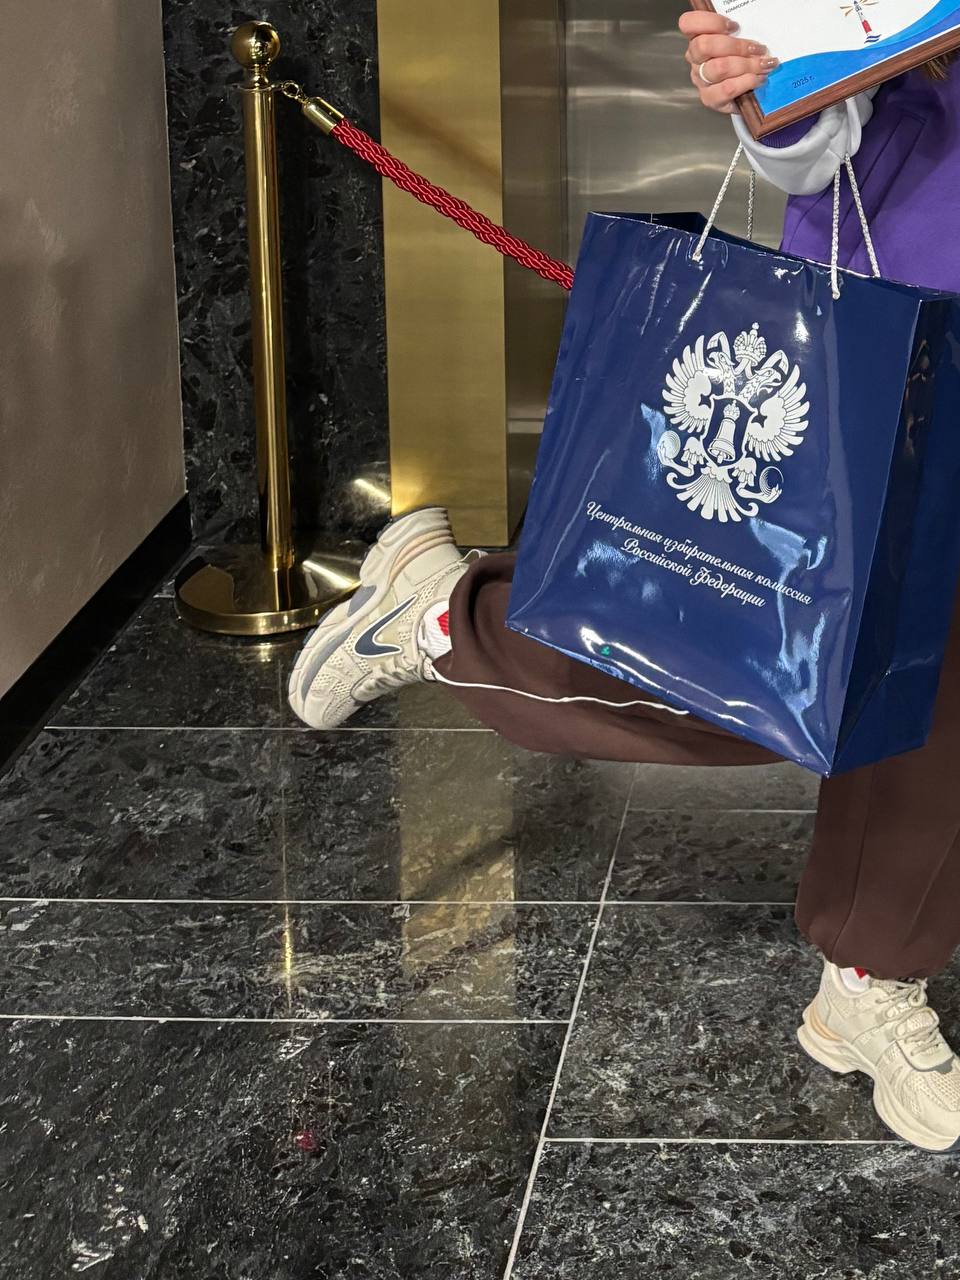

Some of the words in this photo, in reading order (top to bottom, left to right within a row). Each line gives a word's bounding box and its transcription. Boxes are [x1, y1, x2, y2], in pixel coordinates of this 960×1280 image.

[586, 501, 663, 544] Центральная
[663, 535, 755, 580] избирательная
[755, 574, 813, 605] комиссия
[620, 537, 693, 578] Российской
[689, 566, 766, 608] Федерации
